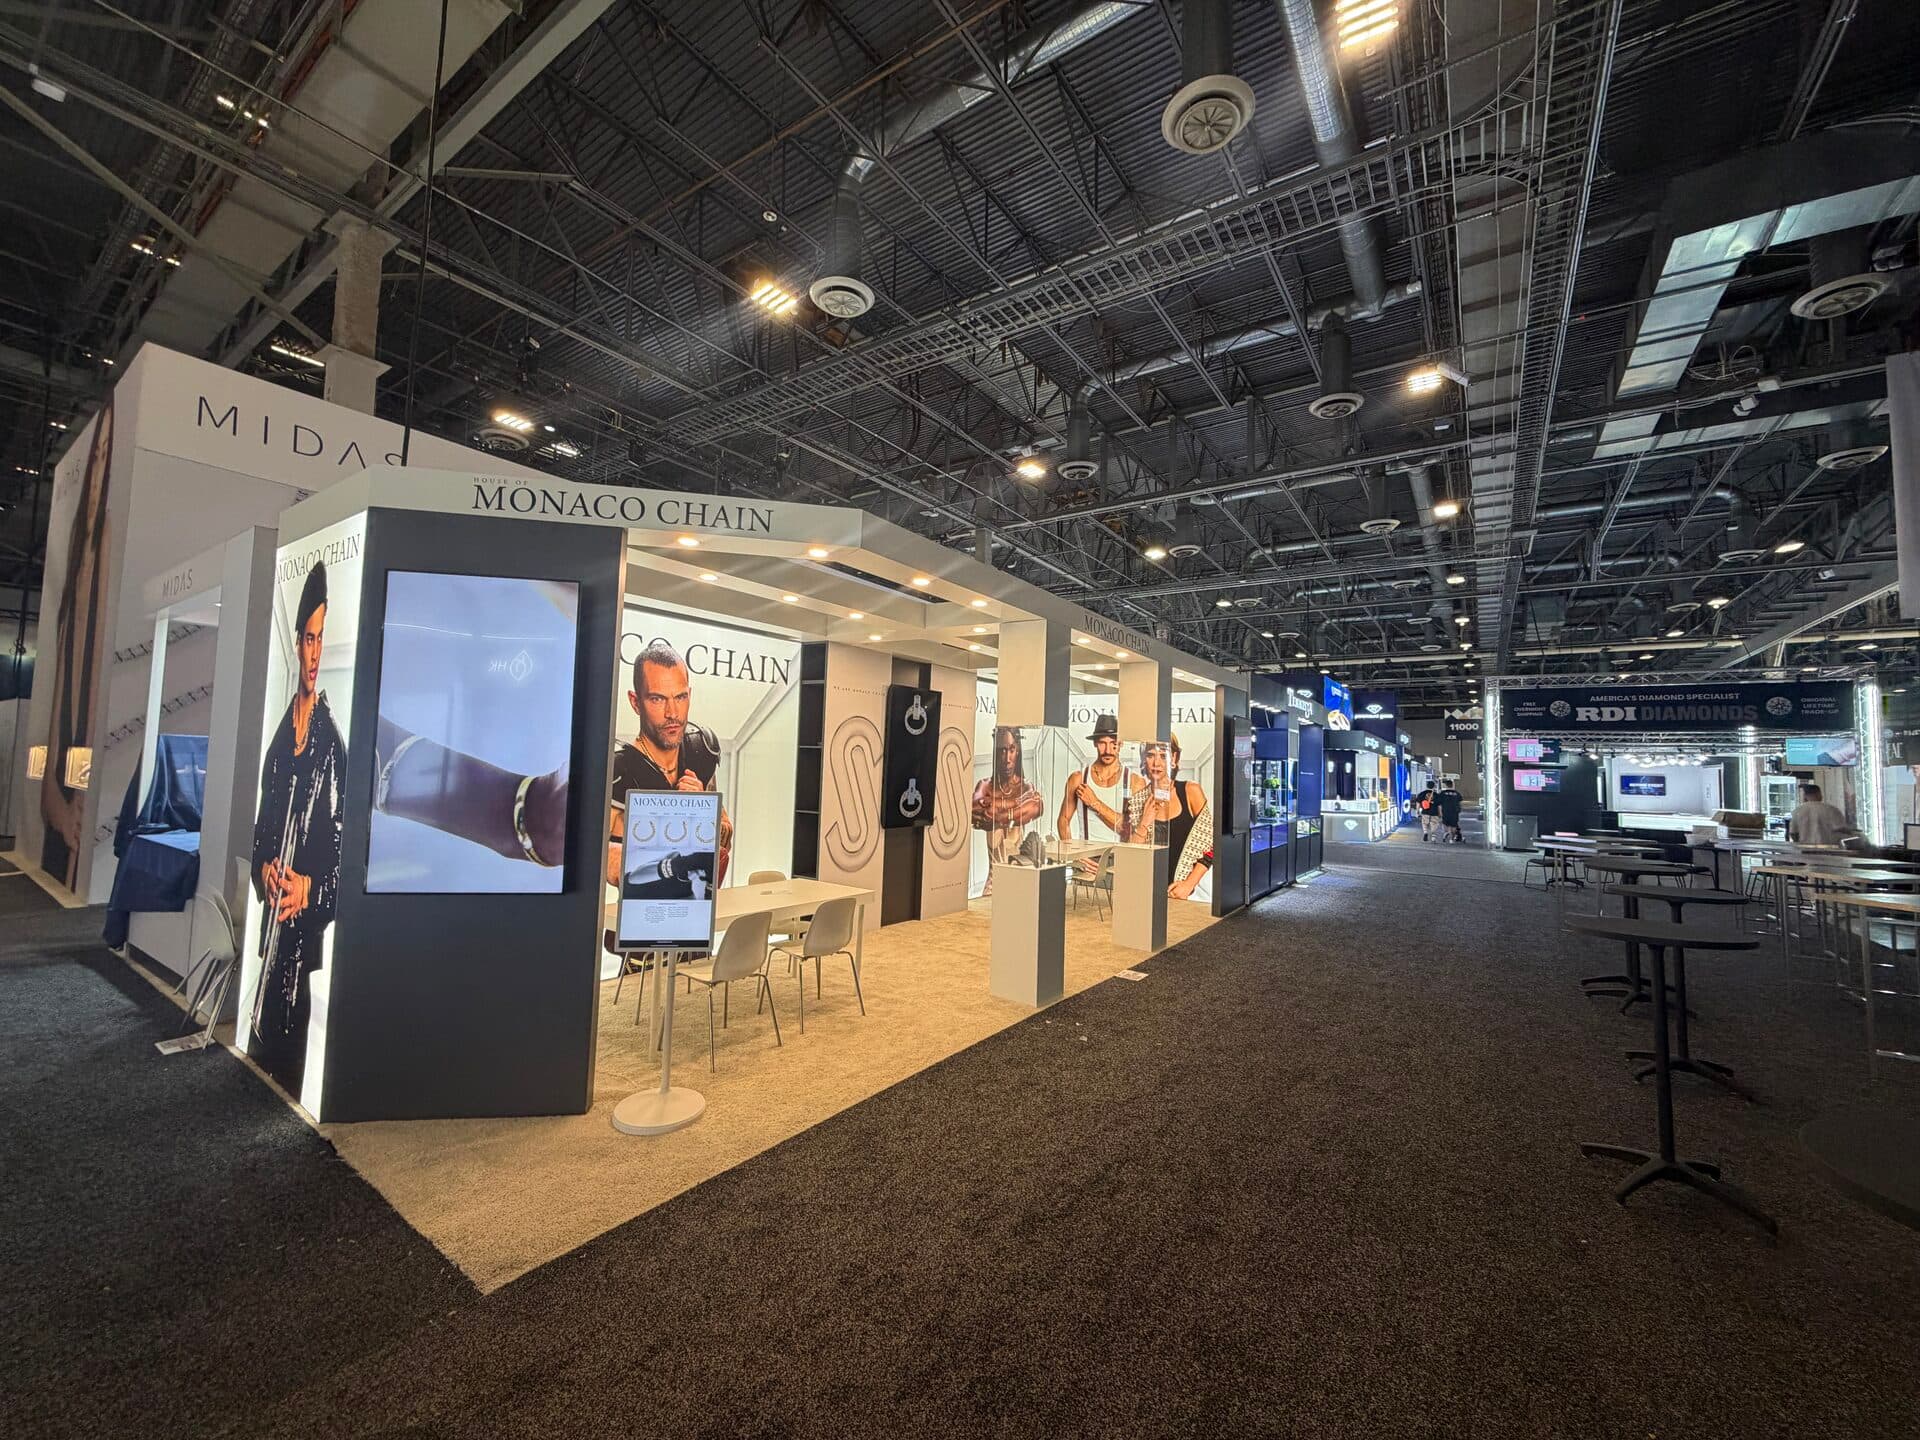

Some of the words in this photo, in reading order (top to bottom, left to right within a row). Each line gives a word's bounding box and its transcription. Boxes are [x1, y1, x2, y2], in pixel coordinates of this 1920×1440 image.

[472, 484, 646, 522] MONACO
[656, 499, 775, 533] CHAIN
[323, 533, 361, 567] CHAIN
[1084, 614, 1125, 645] MONACO
[1125, 632, 1151, 655] CHAIN
[685, 644, 792, 686] CHAIN
[1686, 692, 1741, 700] SPECIALIST
[1575, 706, 1638, 722] RDI
[1640, 704, 1760, 722] DIAMONDS
[1449, 723, 1480, 731] 11000
[633, 797, 678, 808] MONACO
[680, 799, 713, 808] CHAIN
